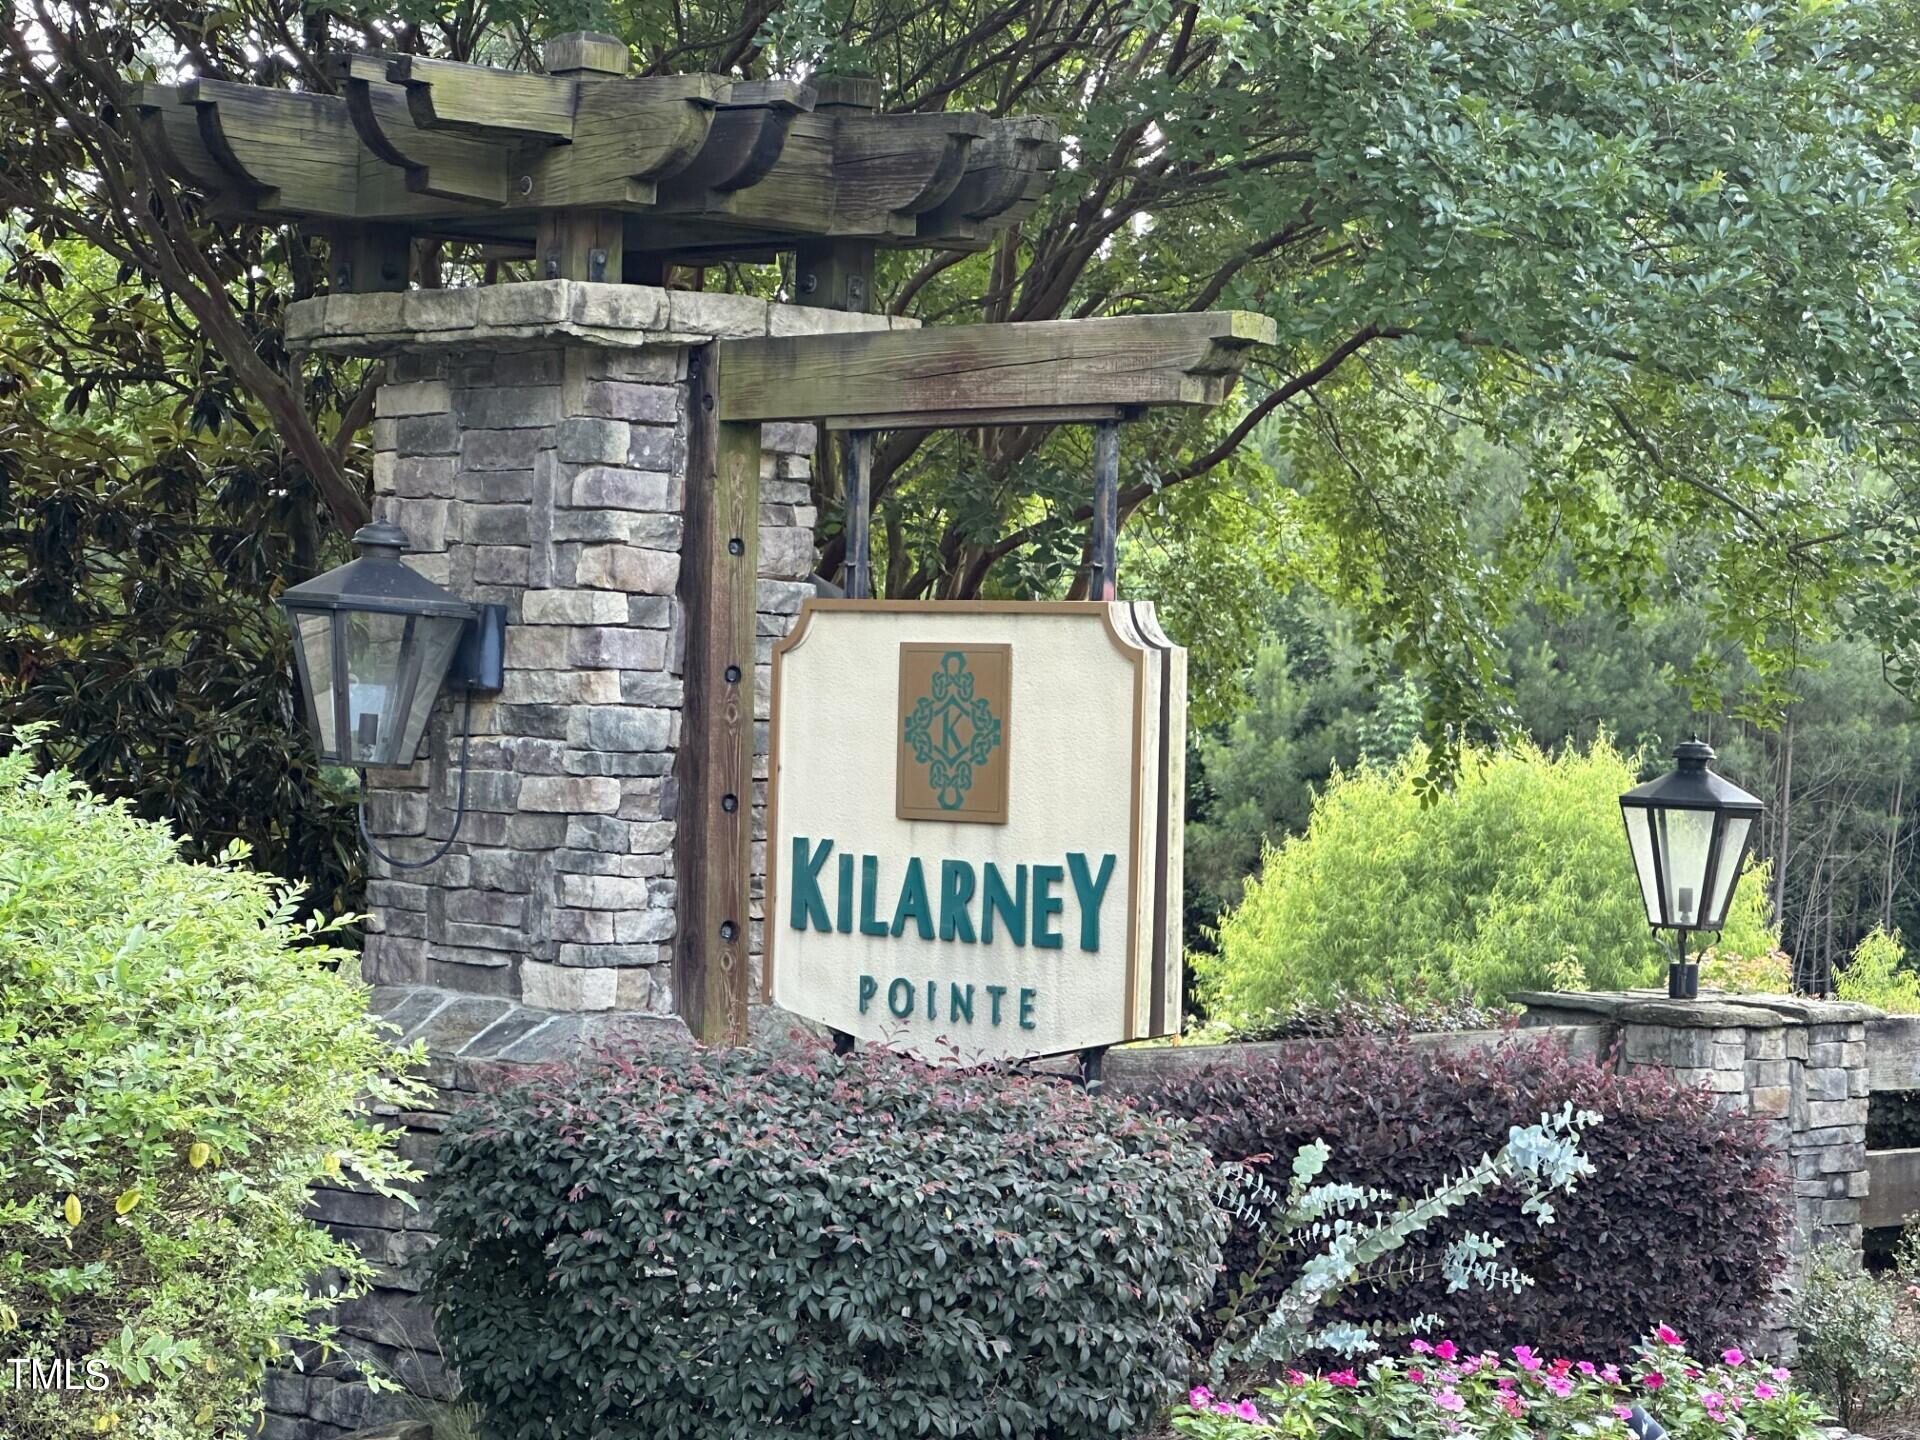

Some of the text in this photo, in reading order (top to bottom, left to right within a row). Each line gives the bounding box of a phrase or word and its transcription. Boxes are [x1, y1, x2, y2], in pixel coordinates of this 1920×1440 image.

[942, 709, 963, 752] K
[790, 836, 1116, 952] KILARNEY
[859, 974, 1038, 1029] POINTE
